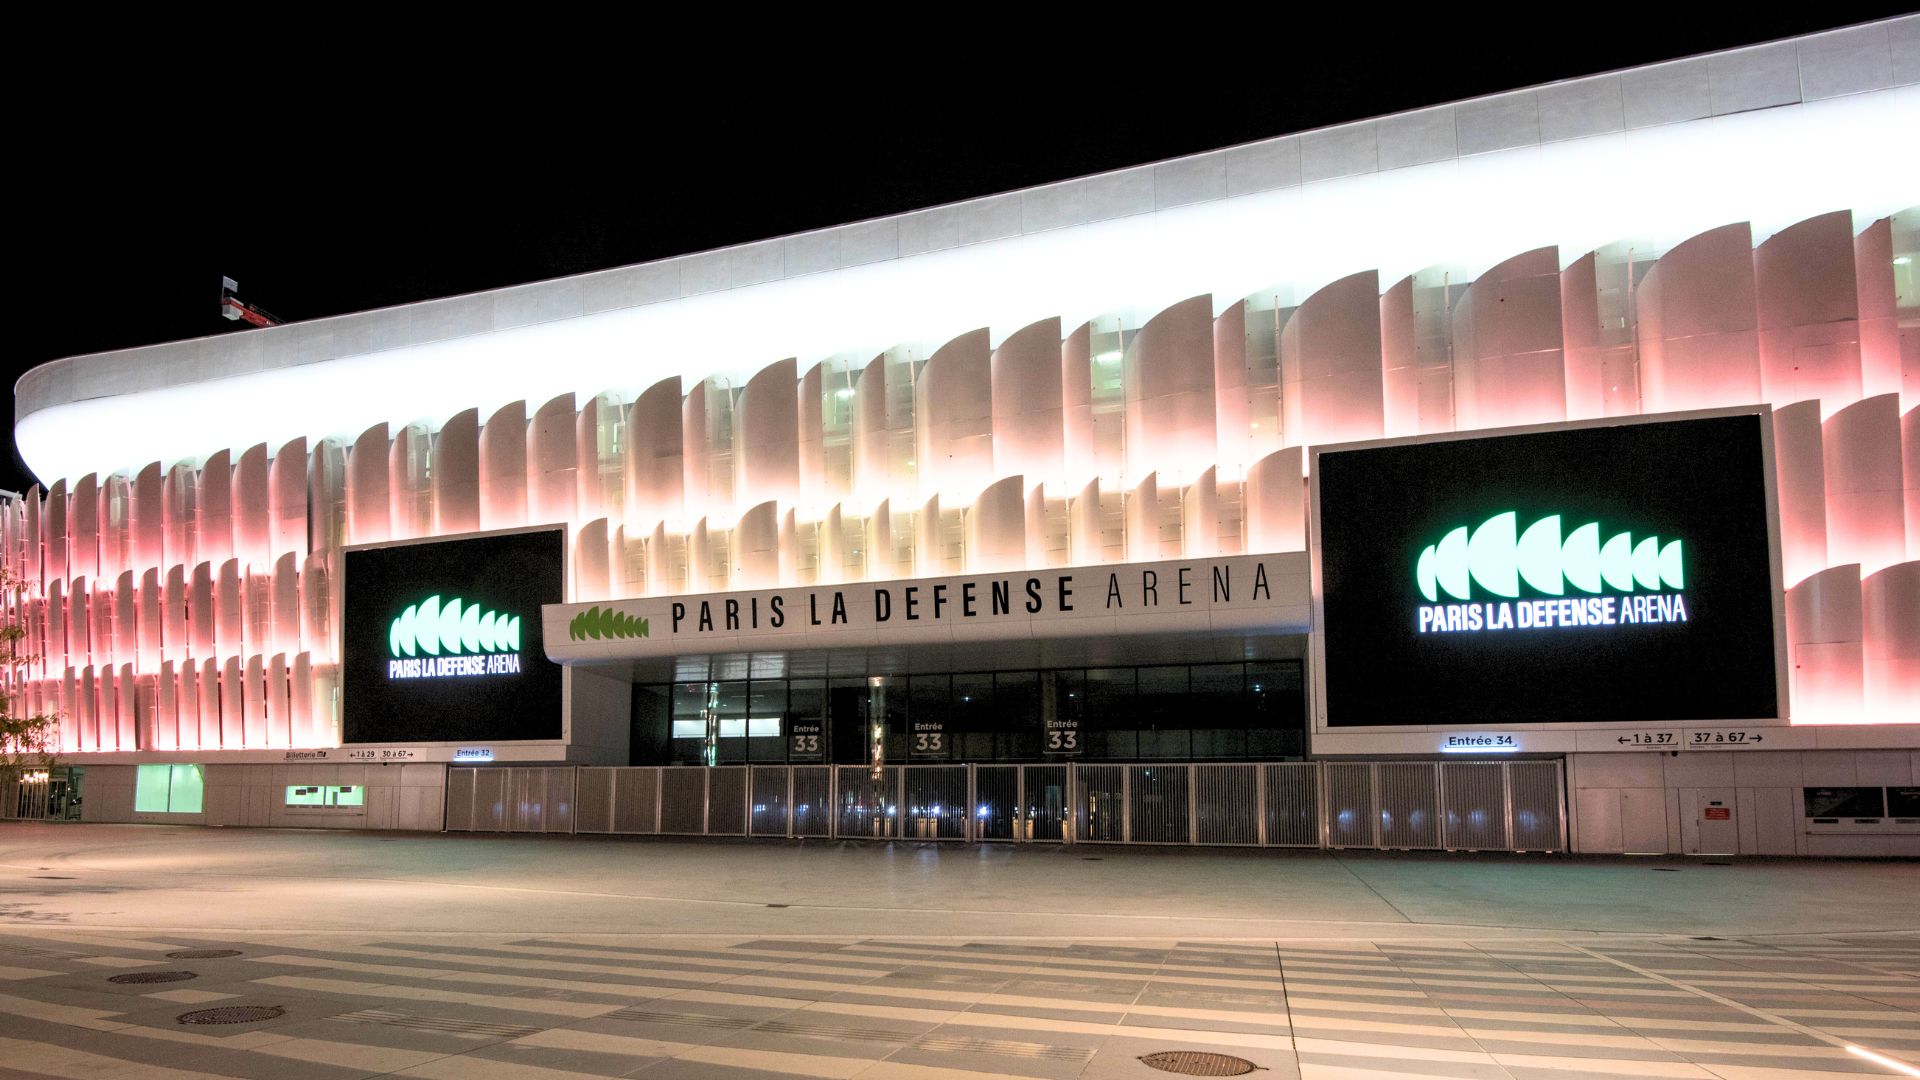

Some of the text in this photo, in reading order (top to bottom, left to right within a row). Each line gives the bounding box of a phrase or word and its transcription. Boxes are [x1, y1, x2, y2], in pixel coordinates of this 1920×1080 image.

[673, 563, 1271, 633] PARIS LA DEFENSE ARENA
[1419, 594, 1688, 633] PARIS LA DEFENSE ARENA
[389, 654, 521, 678] PARIS LA DEFENSE ARENA
[915, 722, 943, 730] Entrée
[1047, 720, 1078, 728] Entrée
[795, 735, 818, 751] 33
[916, 733, 942, 750] 33
[1048, 731, 1077, 749] 33
[1449, 735, 1513, 746] Entrée 34
[1634, 733, 1673, 743] 1 à 37
[1694, 732, 1746, 743] 37 à 67
[456, 749, 480, 757] Entrée
